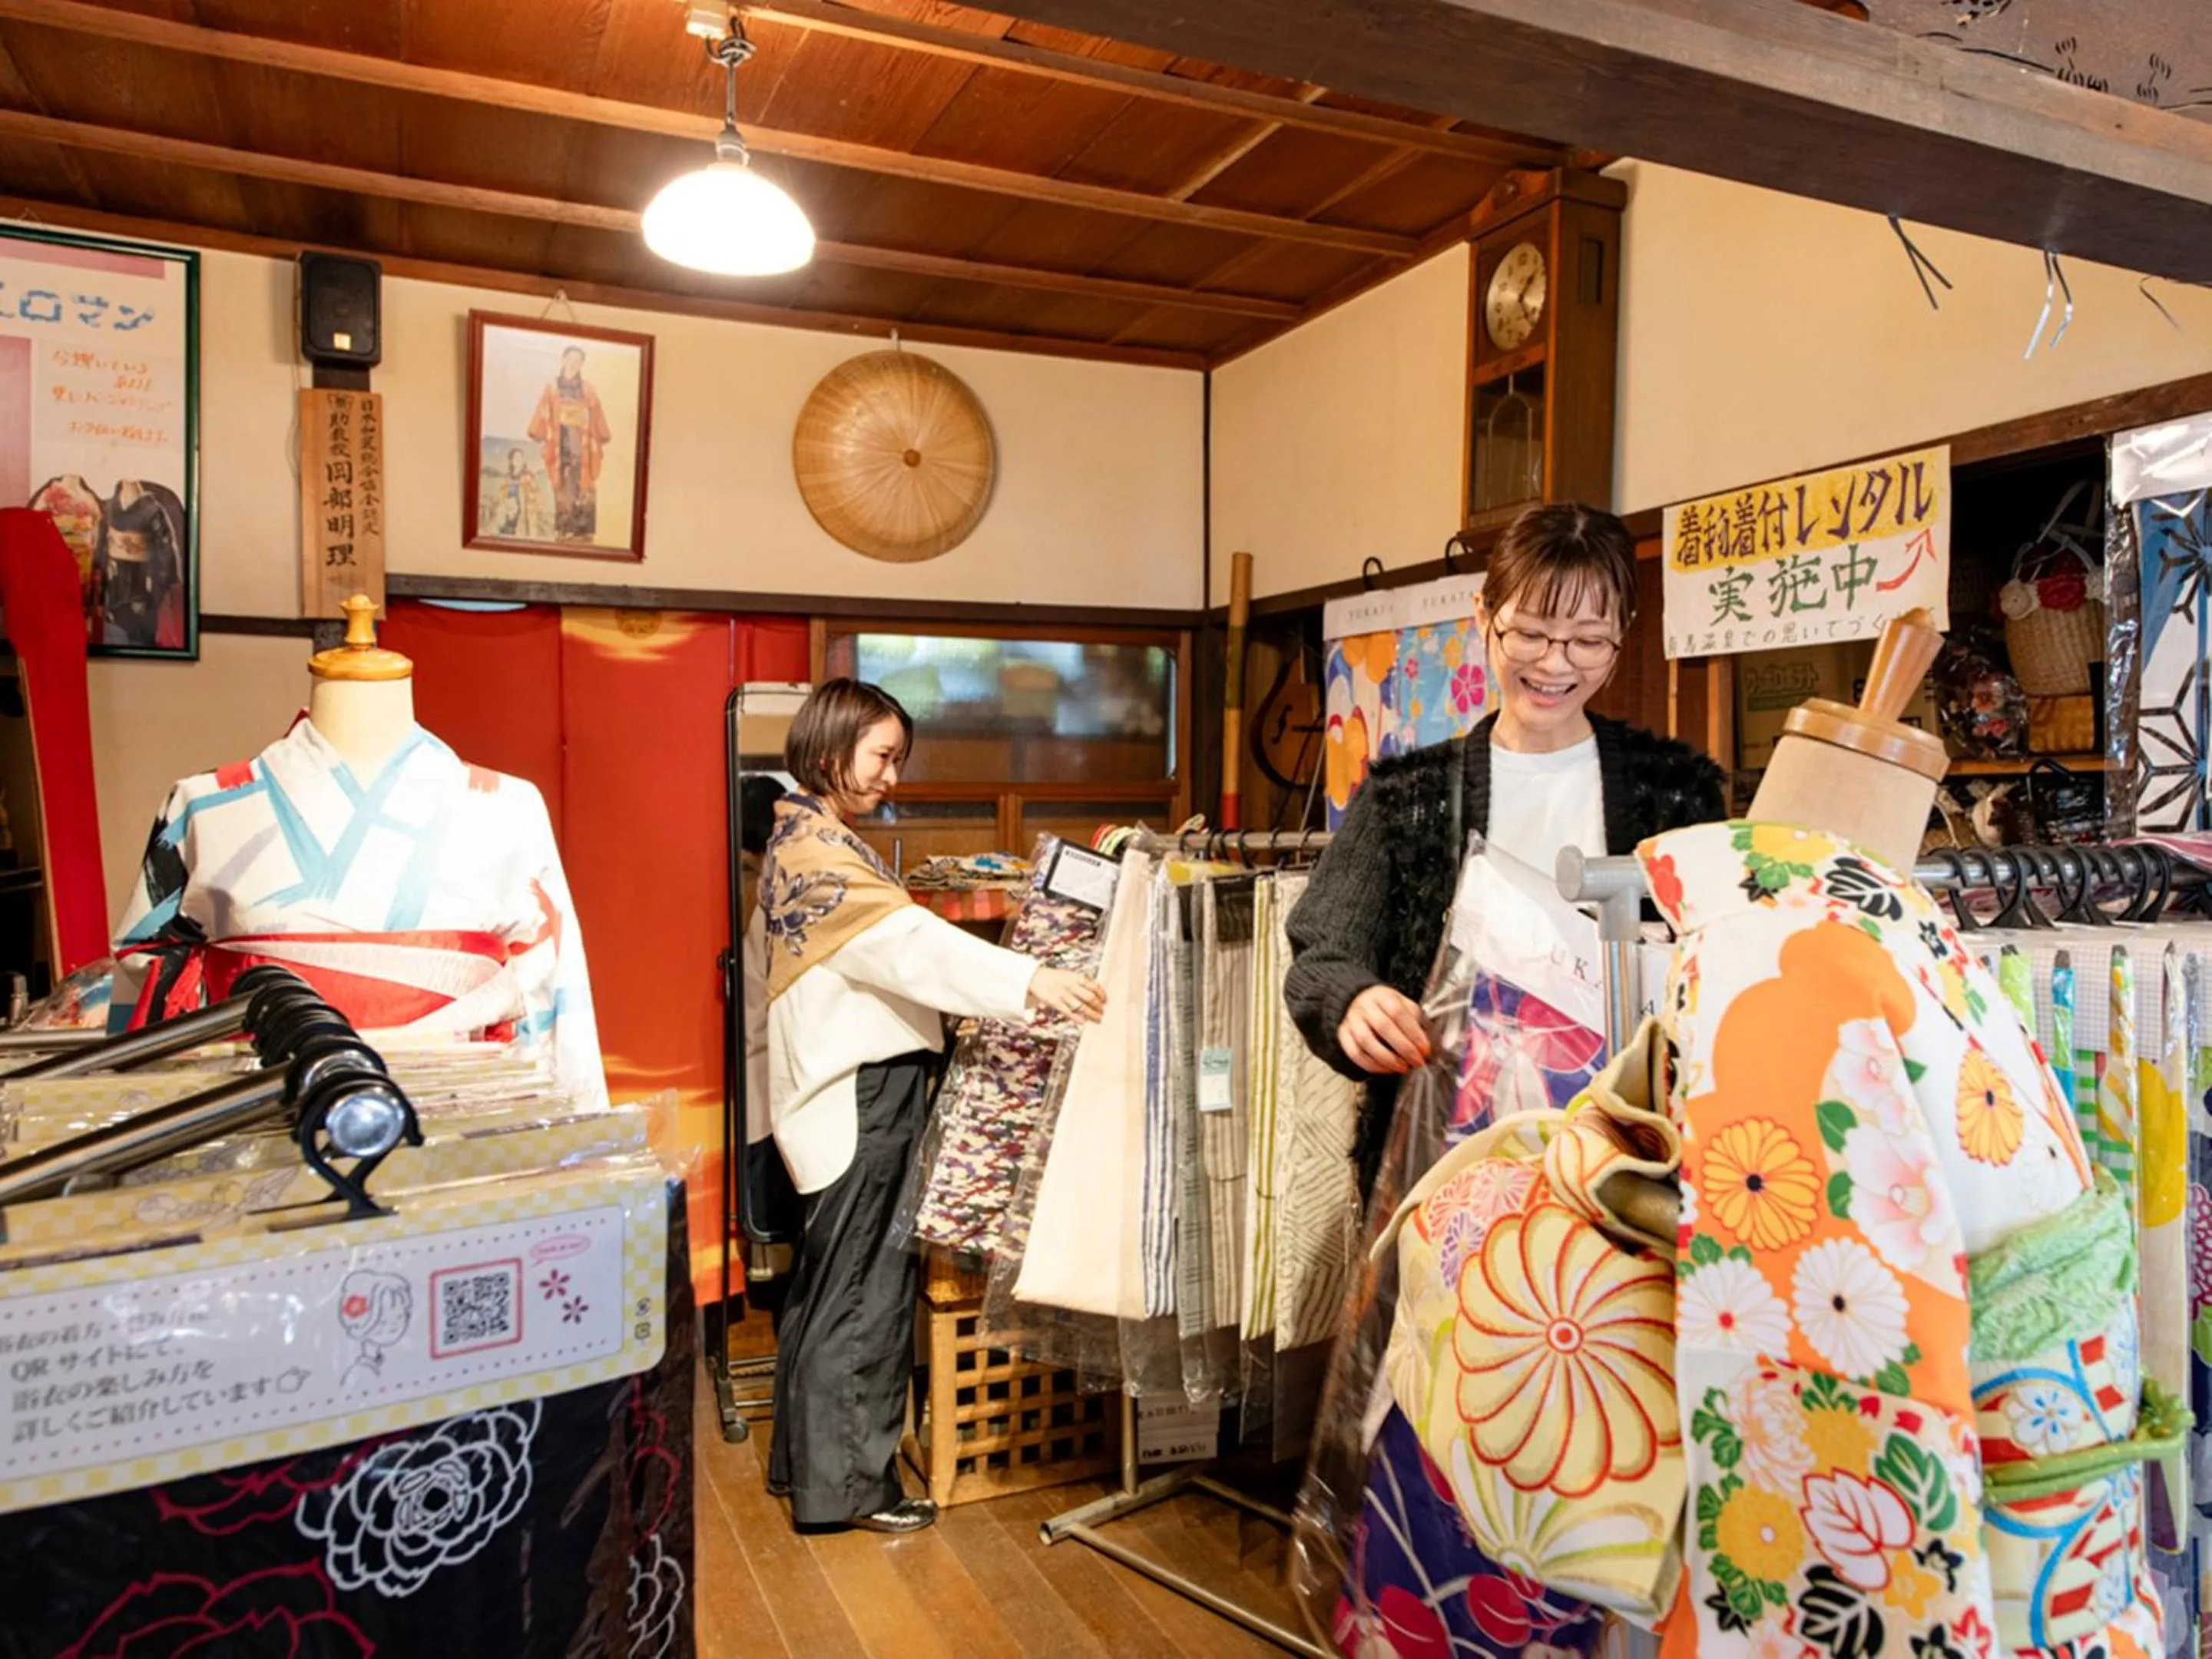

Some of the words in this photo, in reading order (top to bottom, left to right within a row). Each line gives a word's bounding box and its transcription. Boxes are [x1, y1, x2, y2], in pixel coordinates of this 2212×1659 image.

[0, 280, 156, 330] ロマン
[1707, 542, 1879, 626] 実施中
